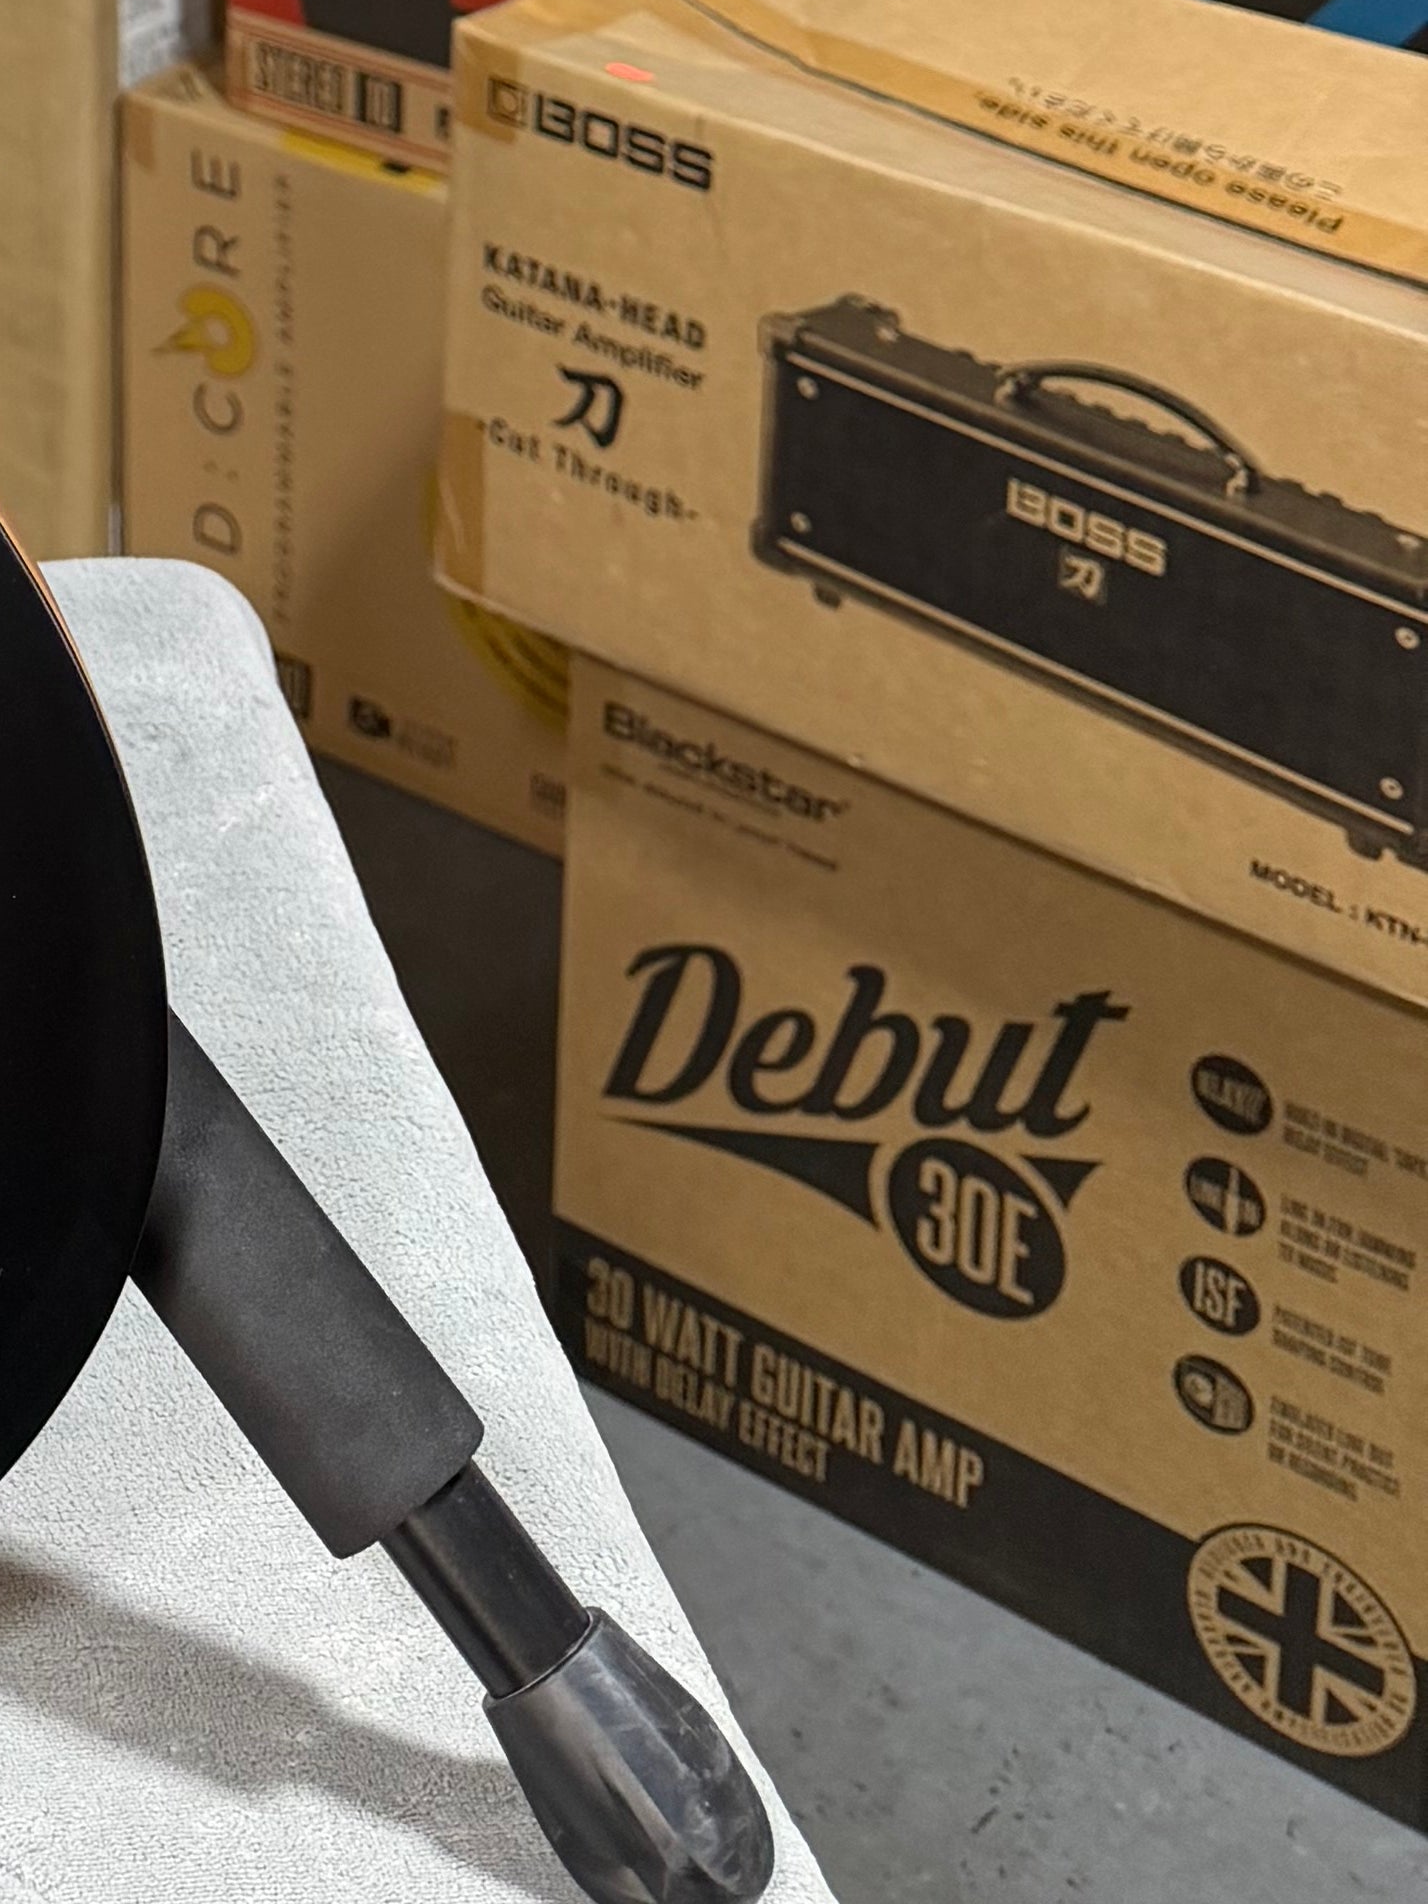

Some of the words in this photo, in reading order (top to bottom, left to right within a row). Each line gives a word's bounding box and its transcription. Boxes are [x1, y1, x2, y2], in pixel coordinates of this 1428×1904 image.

[534, 91, 714, 192] BOSS
[1058, 121, 1120, 156] this
[1127, 146, 1217, 187] open
[1226, 179, 1345, 235] Please
[481, 283, 566, 335] Guitar
[572, 321, 705, 390] Amplifier
[552, 362, 625, 448] 刀
[1005, 476, 1167, 577] BOSS
[1058, 552, 1106, 601] 刀
[602, 698, 844, 823] Blackstar
[1249, 856, 1343, 913] MODEL
[601, 942, 1132, 1138] Debut
[915, 1157, 1038, 1307] 30E
[1193, 1259, 1248, 1328] ISF
[583, 1315, 653, 1390] WITH
[654, 1356, 737, 1433] DELAY
[738, 1397, 834, 1485] EFFECT
[586, 1256, 635, 1331] 30
[643, 1284, 744, 1389] WATT
[750, 1342, 885, 1466] GUITAR
[892, 1418, 985, 1510] AMP
